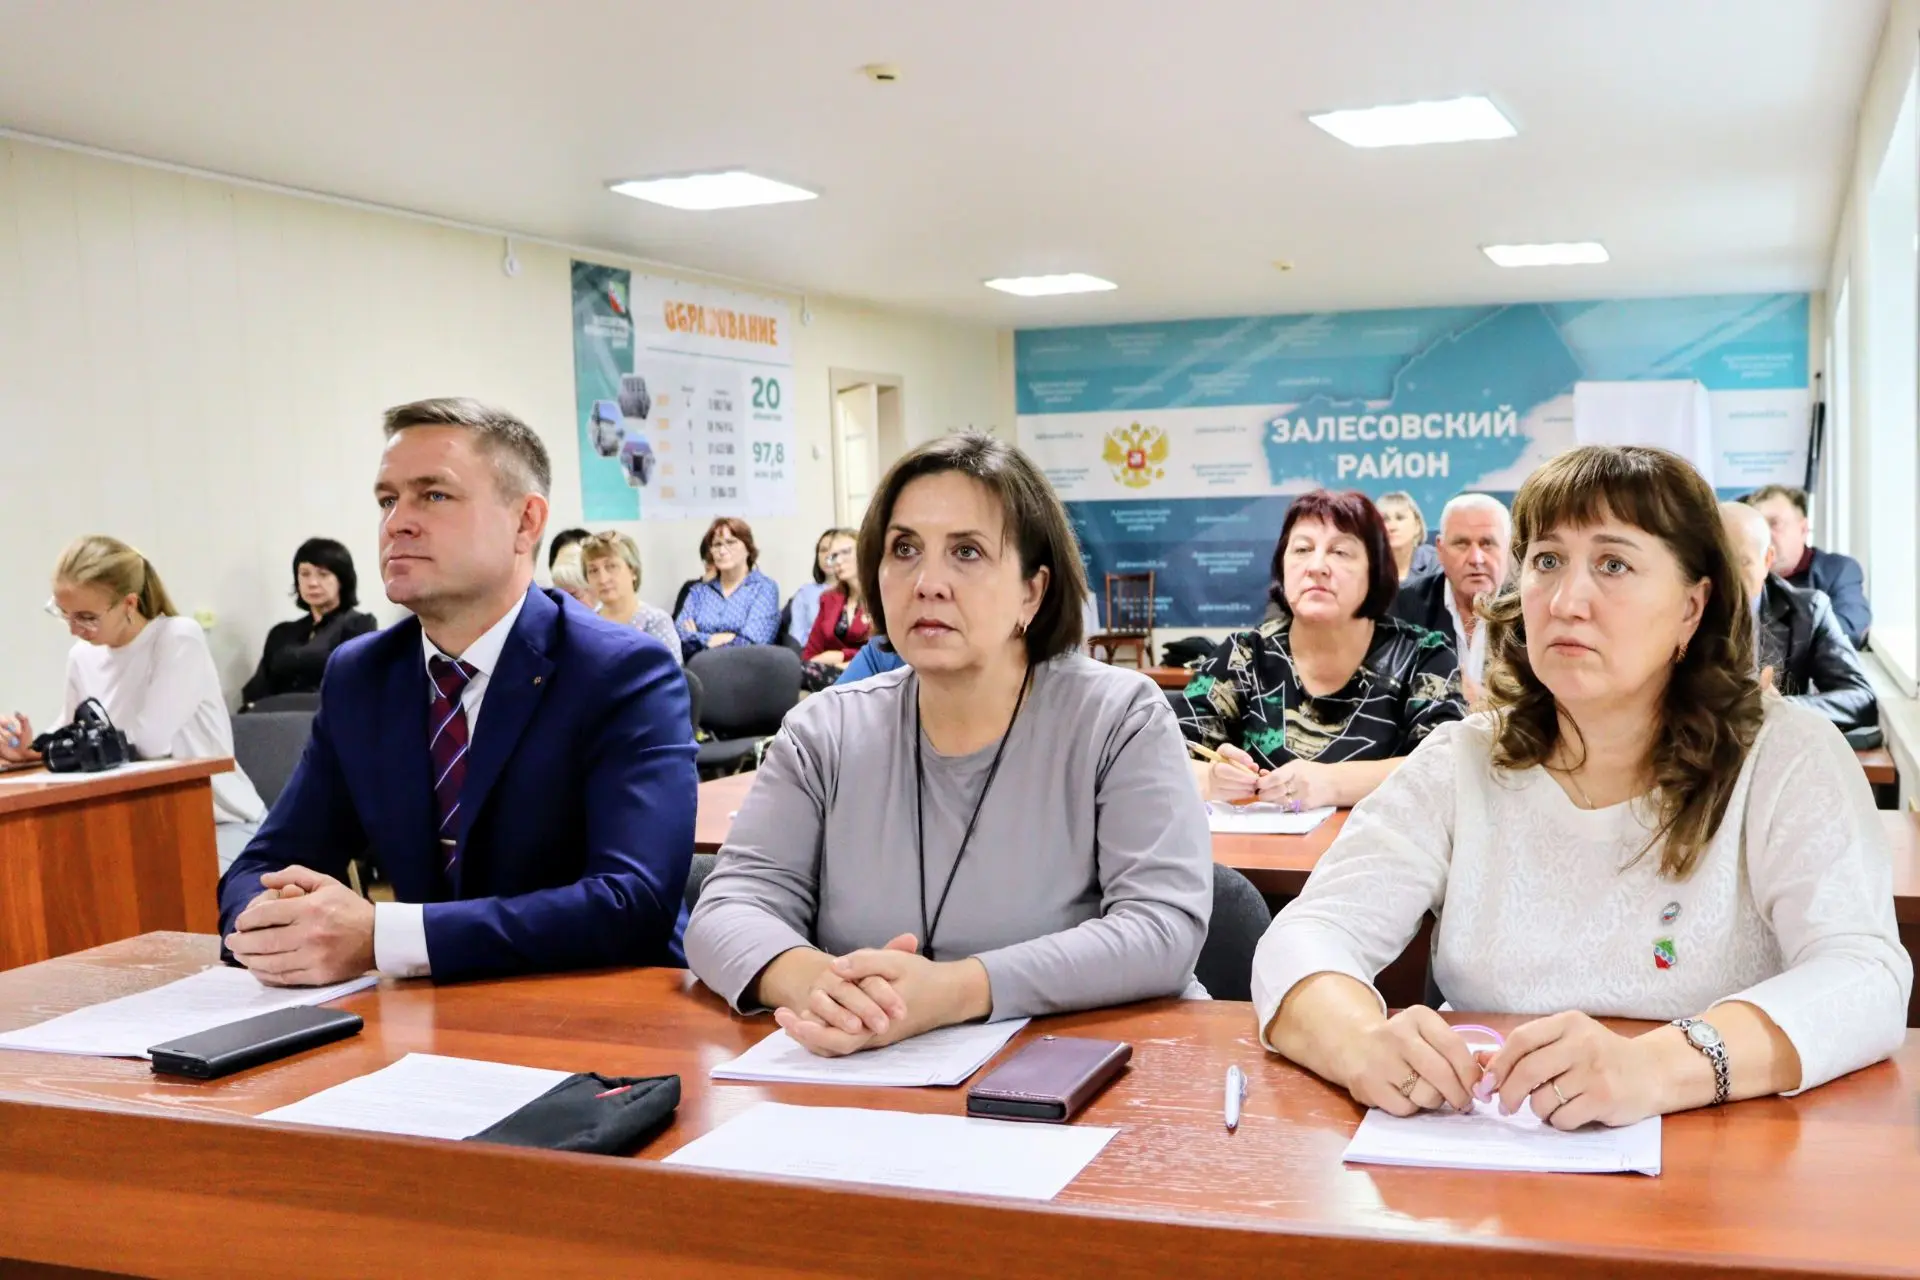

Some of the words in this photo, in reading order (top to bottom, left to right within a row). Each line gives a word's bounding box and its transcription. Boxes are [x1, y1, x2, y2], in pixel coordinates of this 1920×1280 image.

[751, 375, 781, 410] 20
[1271, 404, 1518, 443] ЗАЛЕСОВСКИЙ
[752, 441, 785, 467] 97,8
[1336, 446, 1450, 480] РАЙОН
